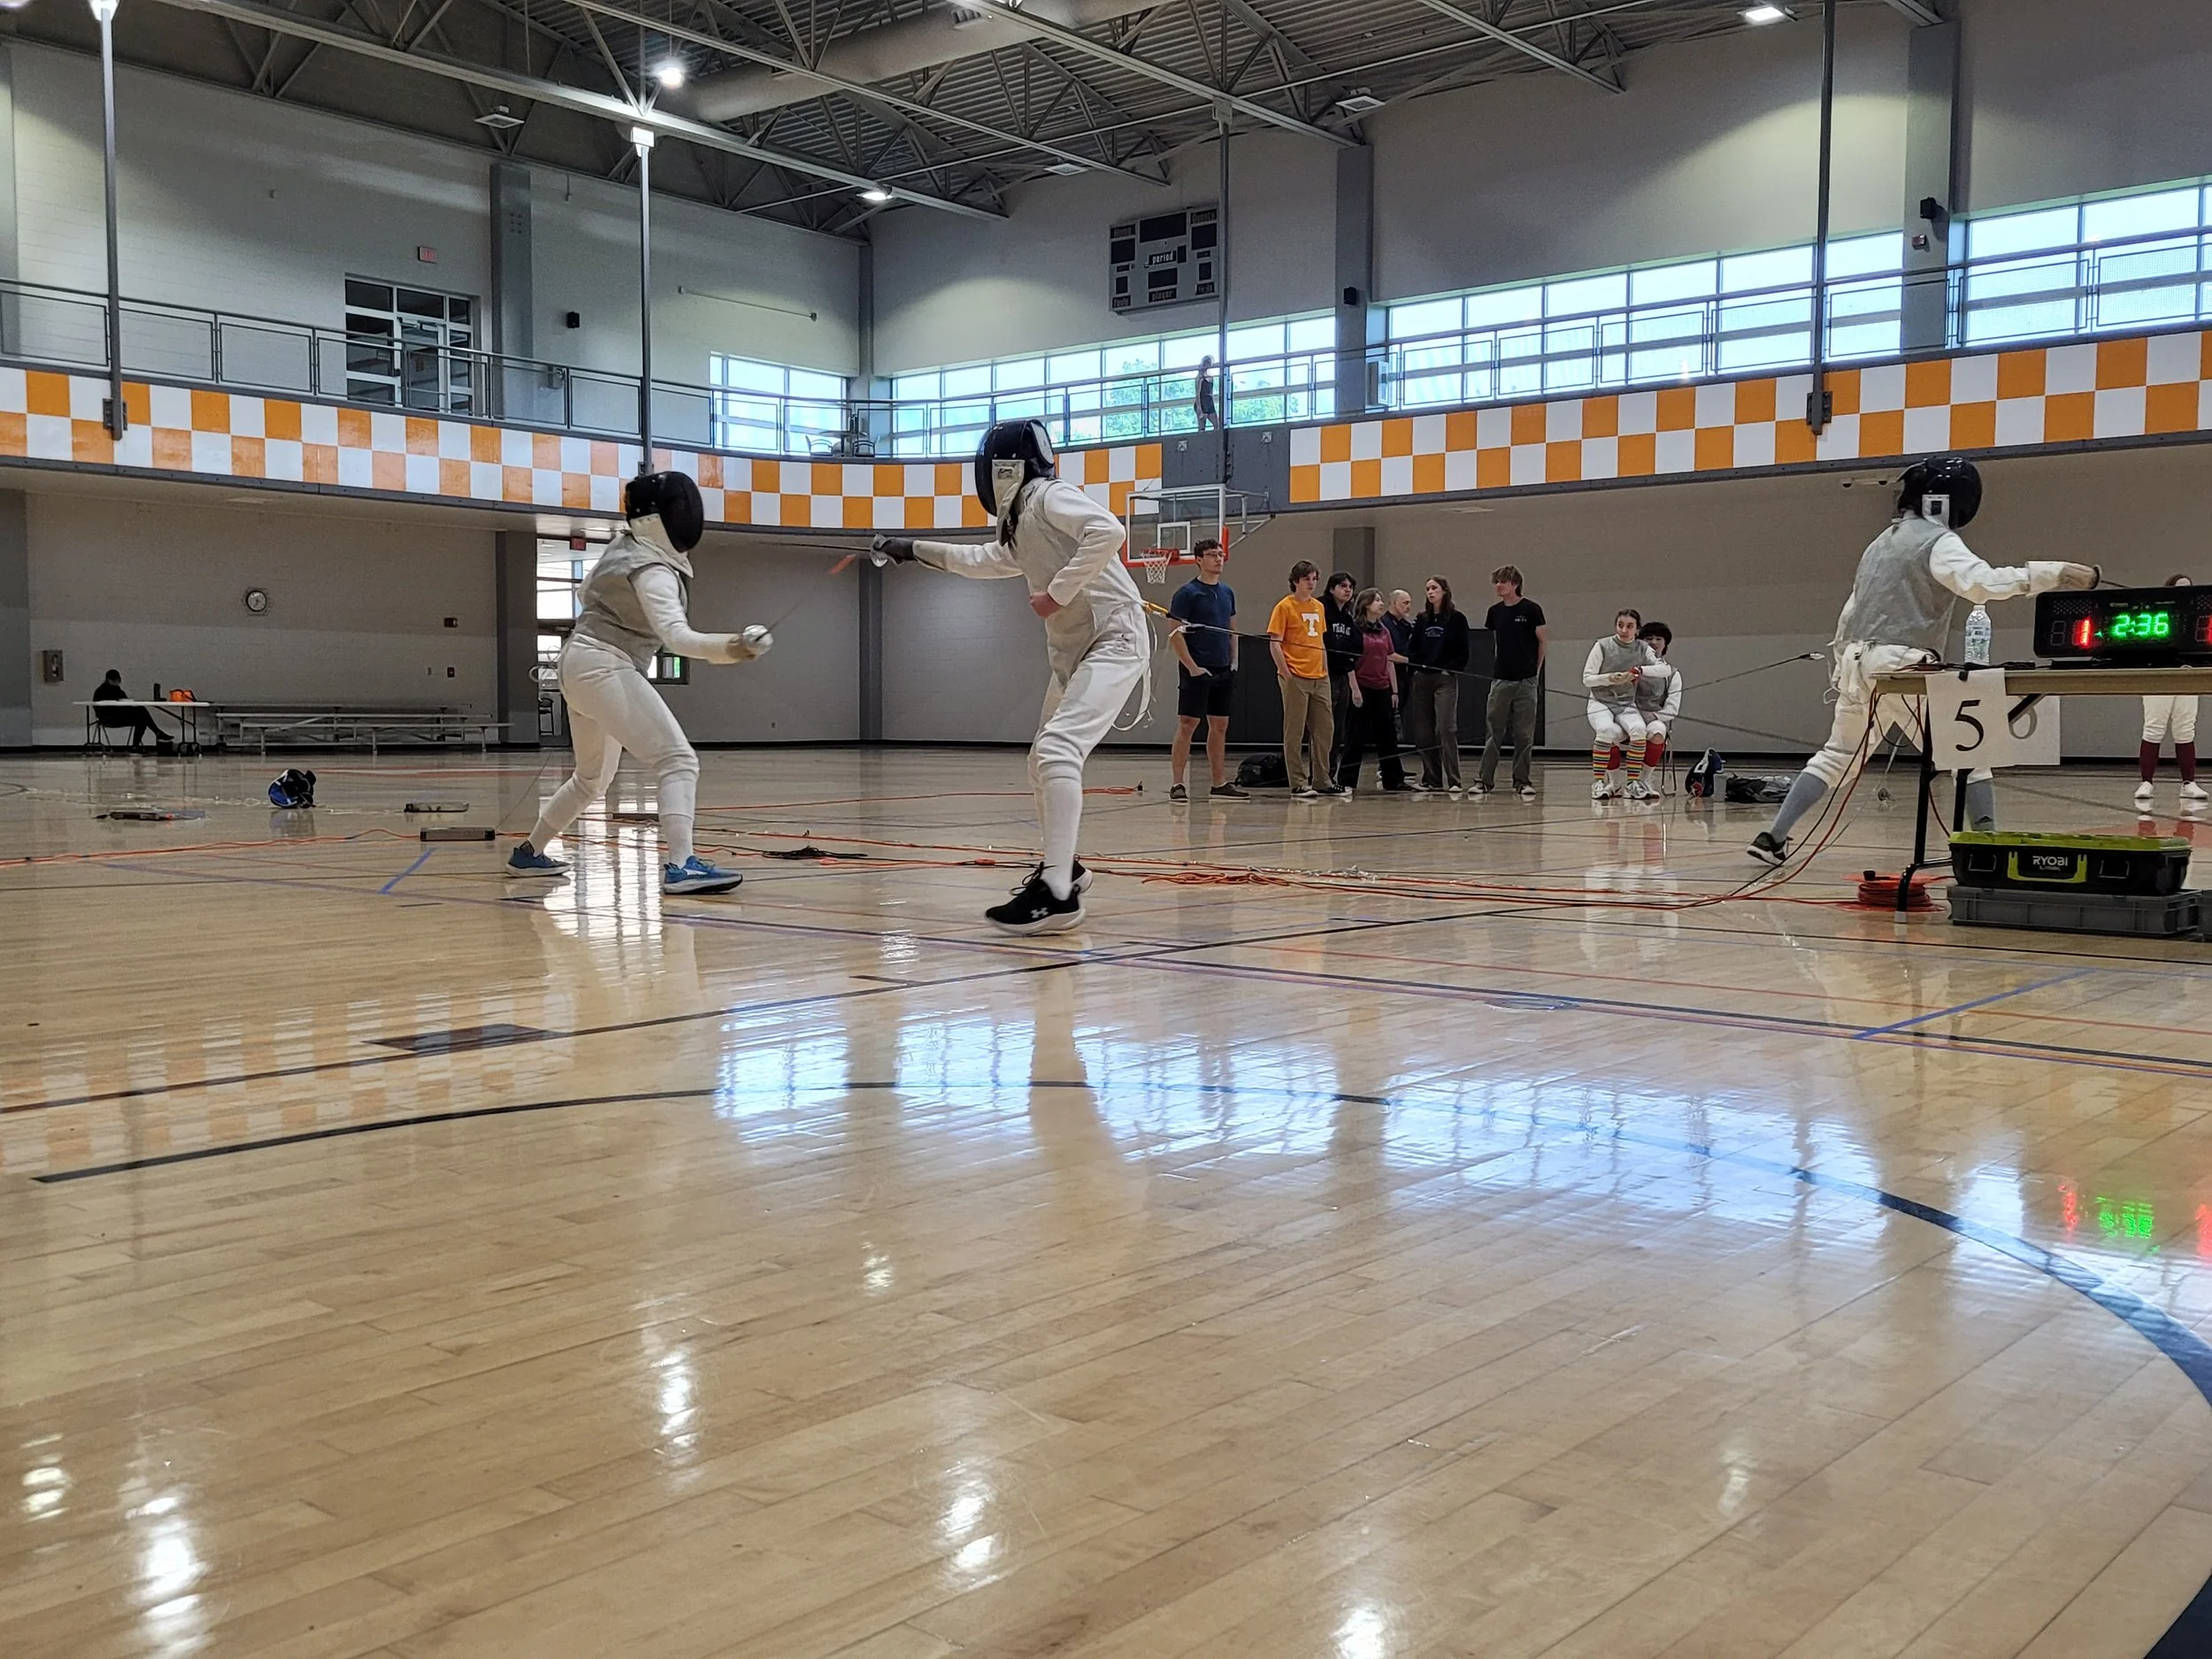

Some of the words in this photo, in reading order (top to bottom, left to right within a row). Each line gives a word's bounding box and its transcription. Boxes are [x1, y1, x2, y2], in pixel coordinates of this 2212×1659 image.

[1152, 250, 1173, 265] period
[1302, 613, 1319, 636] T
[2079, 618, 2091, 647] 1
[2113, 612, 2169, 637] 2:36
[1955, 700, 1984, 751] 5
[2032, 856, 2068, 866] RYOBI
